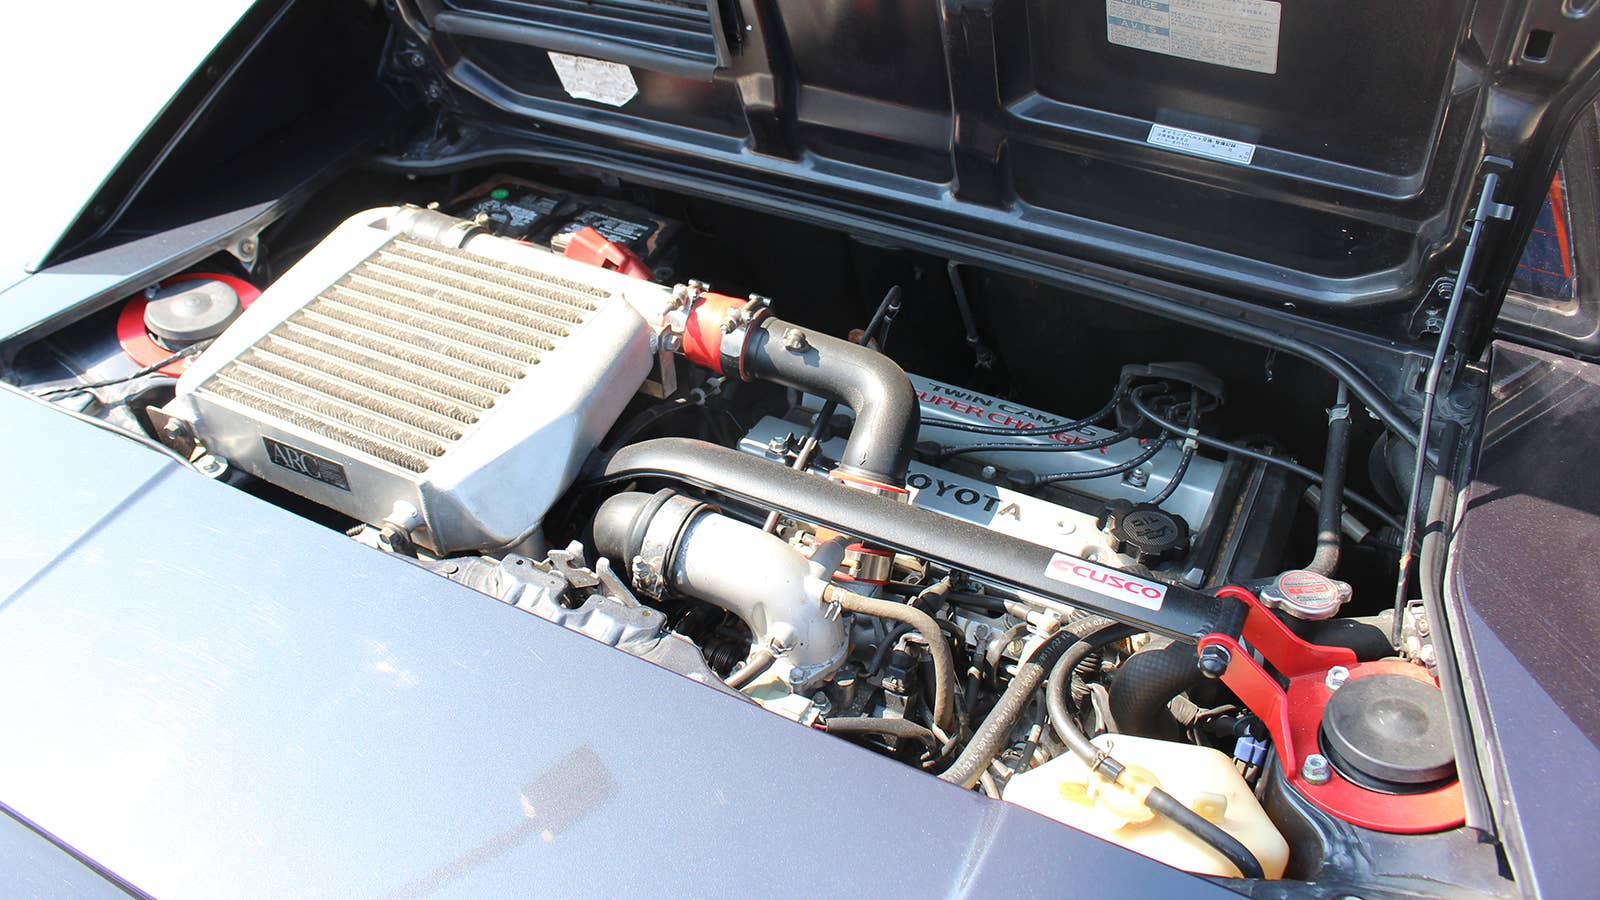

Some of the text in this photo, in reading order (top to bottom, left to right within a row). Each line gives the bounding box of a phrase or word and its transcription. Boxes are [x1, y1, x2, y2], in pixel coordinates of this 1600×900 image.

[1121, 20, 1157, 33] AVIS
[930, 383, 994, 407] TWIN
[998, 402, 1061, 426] CAM
[273, 443, 322, 479] ARC
[906, 471, 1021, 522] OYOTA
[1072, 565, 1161, 599] CUSCO
